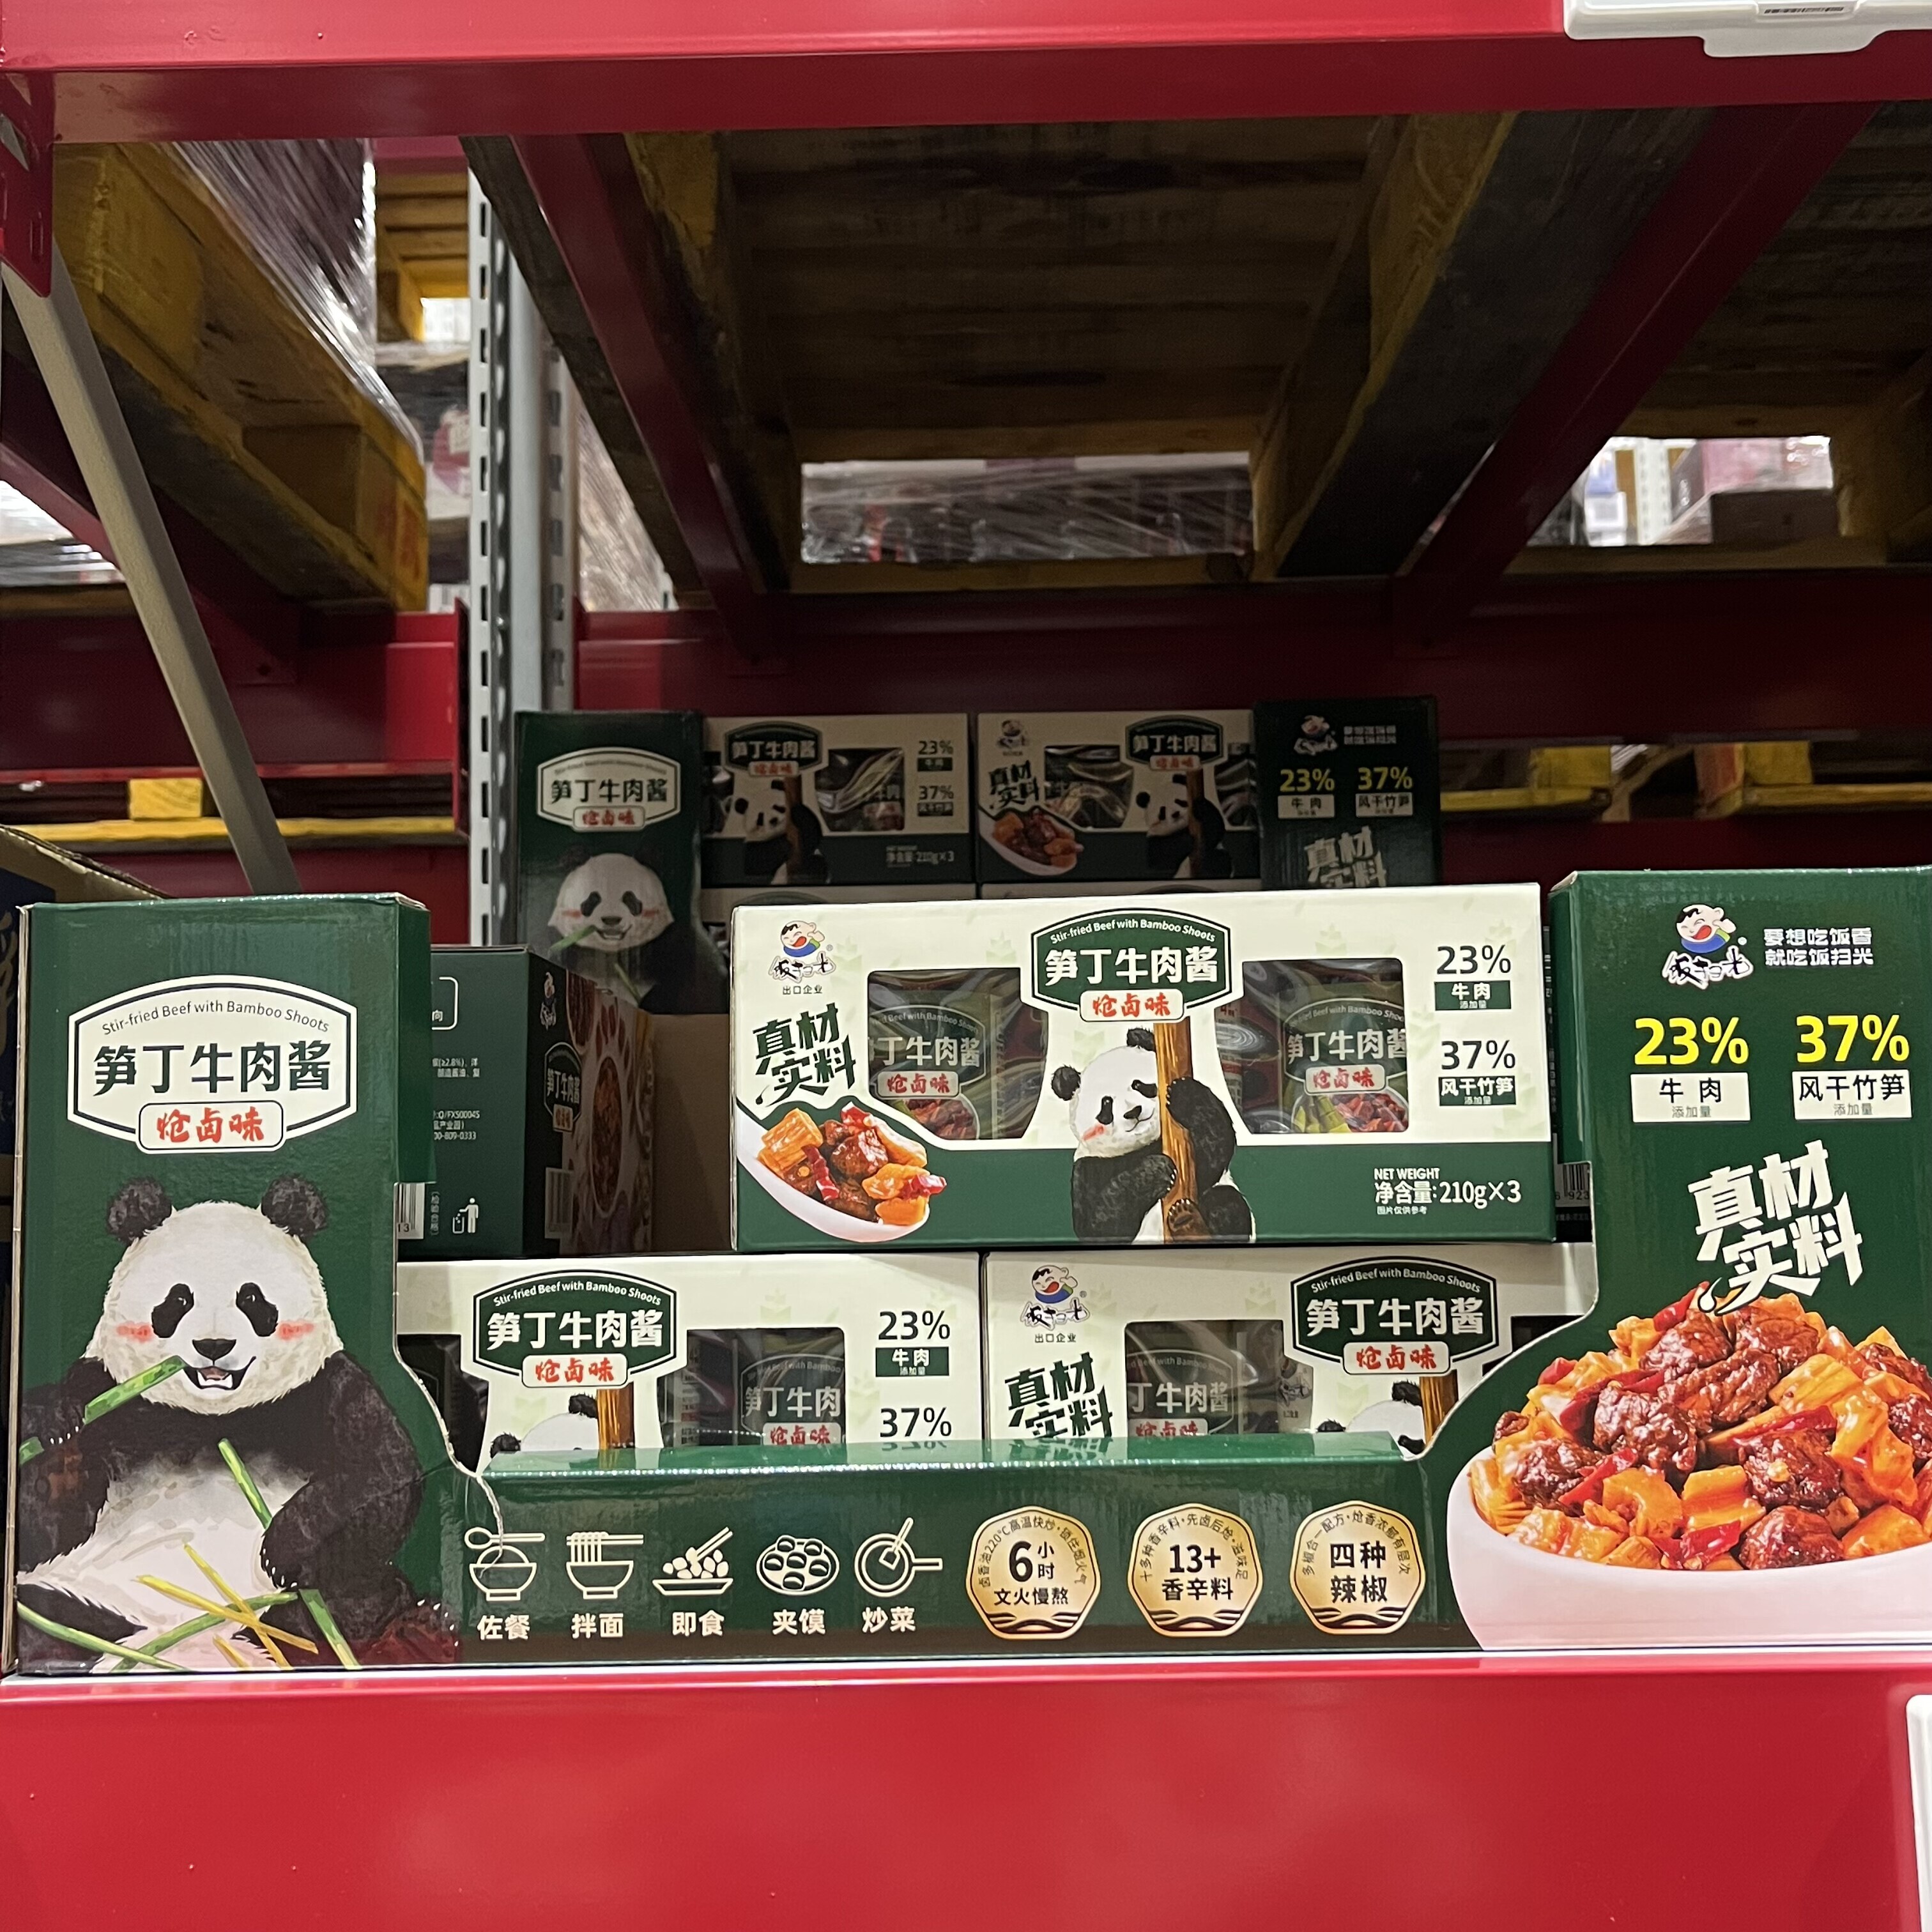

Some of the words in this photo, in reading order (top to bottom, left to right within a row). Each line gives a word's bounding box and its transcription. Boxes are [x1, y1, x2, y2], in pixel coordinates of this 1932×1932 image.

[919, 740, 954, 755] 23%
[551, 778, 668, 804] 笋丁牛肉酱
[919, 786, 954, 799] 37%
[1280, 769, 1335, 792] 23%
[1358, 767, 1413, 790] 37%
[1304, 825, 1374, 882] 真材
[1050, 924, 1092, 944] Stir-fried
[1093, 919, 1115, 932] Beef
[1116, 919, 1138, 928] with
[1140, 919, 1181, 933] Bamboo
[1183, 924, 1216, 942] Shoots
[1764, 927, 1872, 947] 要想吃饭香
[1045, 946, 1218, 986] 笋丁牛肉酱
[1436, 944, 1511, 974] 23%
[1765, 947, 1874, 967] 就吃饭扫光
[783, 985, 822, 995] 出口企业
[1452, 983, 1491, 1000] 牛肉
[102, 1006, 159, 1036] Stir-fried
[162, 1001, 192, 1018] Beef
[194, 1000, 223, 1013] with
[227, 1000, 282, 1018] Bamboo
[284, 1009, 330, 1032] Shoots
[907, 1012, 925, 1020] with
[1092, 992, 1170, 1017] 炝卤味
[1330, 1006, 1346, 1014] with
[1347, 1006, 1383, 1016] Bamboo
[753, 1002, 839, 1075] 真材
[869, 1036, 980, 1067] 丁牛肉酱
[1287, 1029, 1406, 1064] 笋丁牛肉酱
[1634, 1016, 1749, 1065] 23%
[1796, 1015, 1910, 1062] 37%
[1441, 1039, 1515, 1070] 37%
[93, 1040, 331, 1097] 笋丁牛肉酱
[765, 1034, 856, 1107] 实料
[1313, 1068, 1375, 1089] 炝卤味
[887, 1073, 950, 1094] 炝卤味
[1441, 1077, 1514, 1096] 风干竹笋
[1660, 1078, 1721, 1103] 牛肉
[1800, 1074, 1905, 1102] 风干竹笋
[1672, 1105, 1712, 1118] 添加量
[1833, 1103, 1873, 1116] 添加量
[157, 1106, 265, 1142] 炝卤味
[1374, 1169, 1395, 1180] NET
[1396, 1167, 1440, 1180] WEIGHT
[1687, 1139, 1833, 1261] 真材
[1715, 1192, 1863, 1314] 实料
[493, 1285, 537, 1307] Stir-fried
[538, 1282, 562, 1294] Beef
[562, 1280, 584, 1291] with
[586, 1280, 627, 1296] Bamboo
[628, 1287, 662, 1307] Shoots
[1311, 1271, 1354, 1294] Stir-fried
[1355, 1268, 1377, 1281] Beef
[1379, 1268, 1402, 1278] with
[1403, 1268, 1445, 1283] Bamboo
[1446, 1275, 1481, 1294] Shoots
[487, 1309, 663, 1350] 笋丁牛肉酱
[878, 1310, 951, 1340] 23%
[1306, 1297, 1483, 1337] 笋丁牛肉酱
[1035, 1333, 1077, 1343] 出口企业
[535, 1357, 614, 1383] 炝卤味
[892, 1349, 930, 1366] 牛肉
[1356, 1344, 1437, 1370] 炝卤味
[746, 1386, 841, 1418] 笋丁牛肉
[1004, 1351, 1094, 1427] 真材
[1128, 1382, 1229, 1413] 丁牛肉酱
[770, 1425, 831, 1445] 炝卤味
[880, 1407, 952, 1438] 37%
[1009, 1540, 1033, 1583] 6
[1038, 1541, 1055, 1580] 小时
[1170, 1544, 1222, 1573] 13+
[1330, 1540, 1386, 1569] 四种
[994, 1587, 1069, 1606] 文火慢熬
[1162, 1577, 1234, 1601] 香辛料
[1330, 1574, 1388, 1604] 辣椒
[477, 1614, 531, 1641] 佐餐
[571, 1612, 624, 1639] 拌面
[671, 1610, 725, 1636] 即食
[772, 1608, 826, 1635] 夹馍
[862, 1606, 916, 1633] 炒菜
